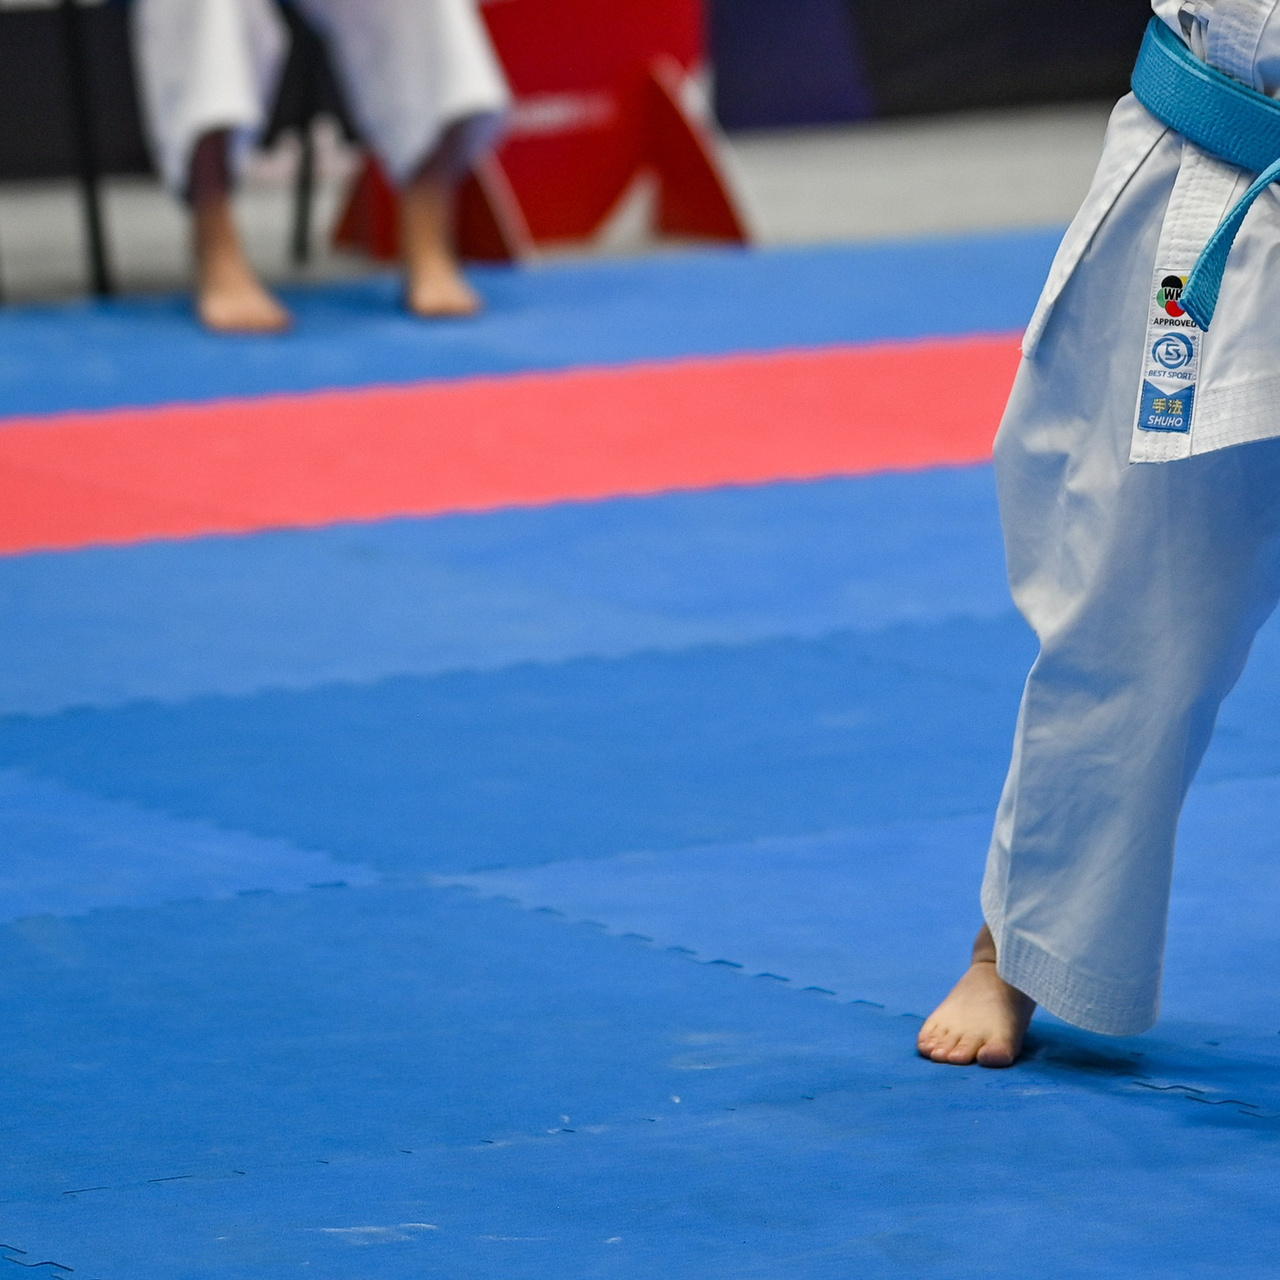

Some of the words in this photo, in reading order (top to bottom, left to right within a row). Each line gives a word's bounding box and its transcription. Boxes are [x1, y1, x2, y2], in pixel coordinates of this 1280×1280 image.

[1164, 288, 1184, 301] WK
[1153, 317, 1197, 328] APPROVED
[1148, 369, 1167, 377] BEST
[1167, 370, 1193, 380] SPORT
[1147, 415, 1183, 427] SHUHO
